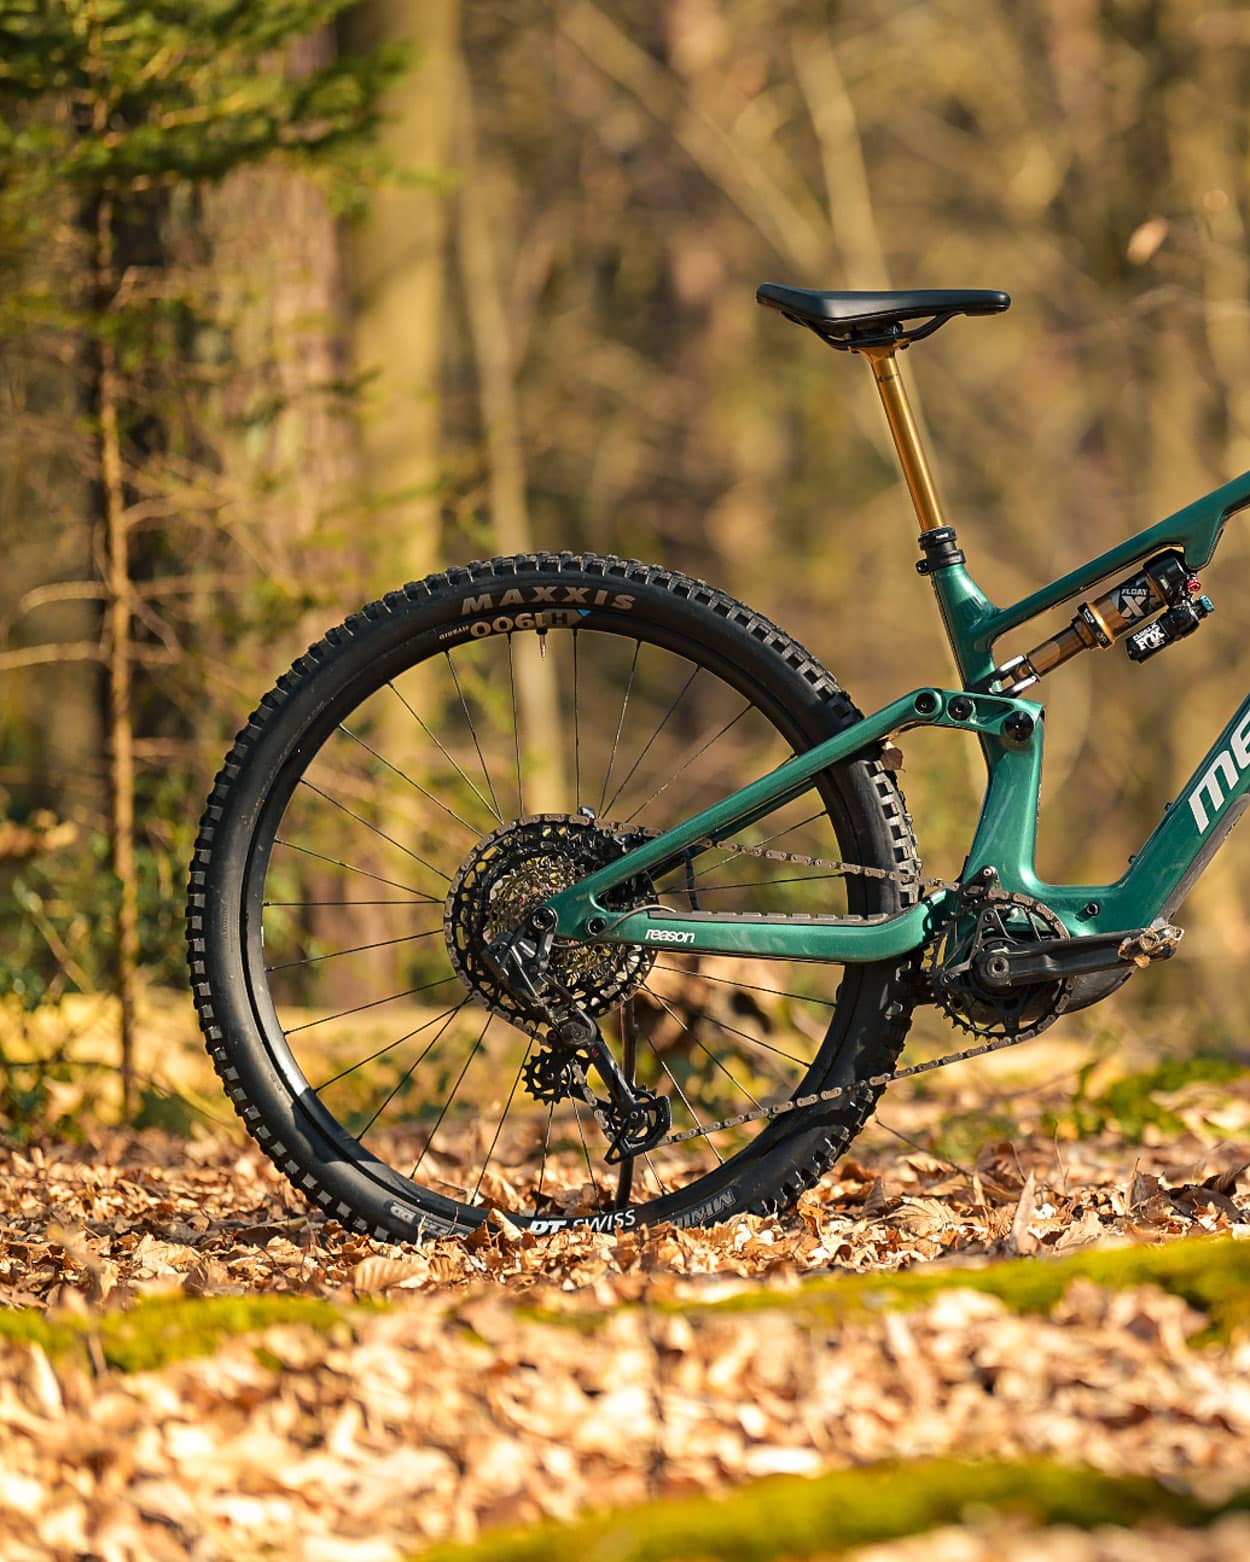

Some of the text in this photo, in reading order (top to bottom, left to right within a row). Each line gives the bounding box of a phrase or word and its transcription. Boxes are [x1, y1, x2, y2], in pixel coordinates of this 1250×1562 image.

[461, 586, 638, 616] MAXXIS
[1136, 628, 1165, 651] FOX
[645, 929, 695, 943] reason
[530, 1219, 568, 1236] DT
